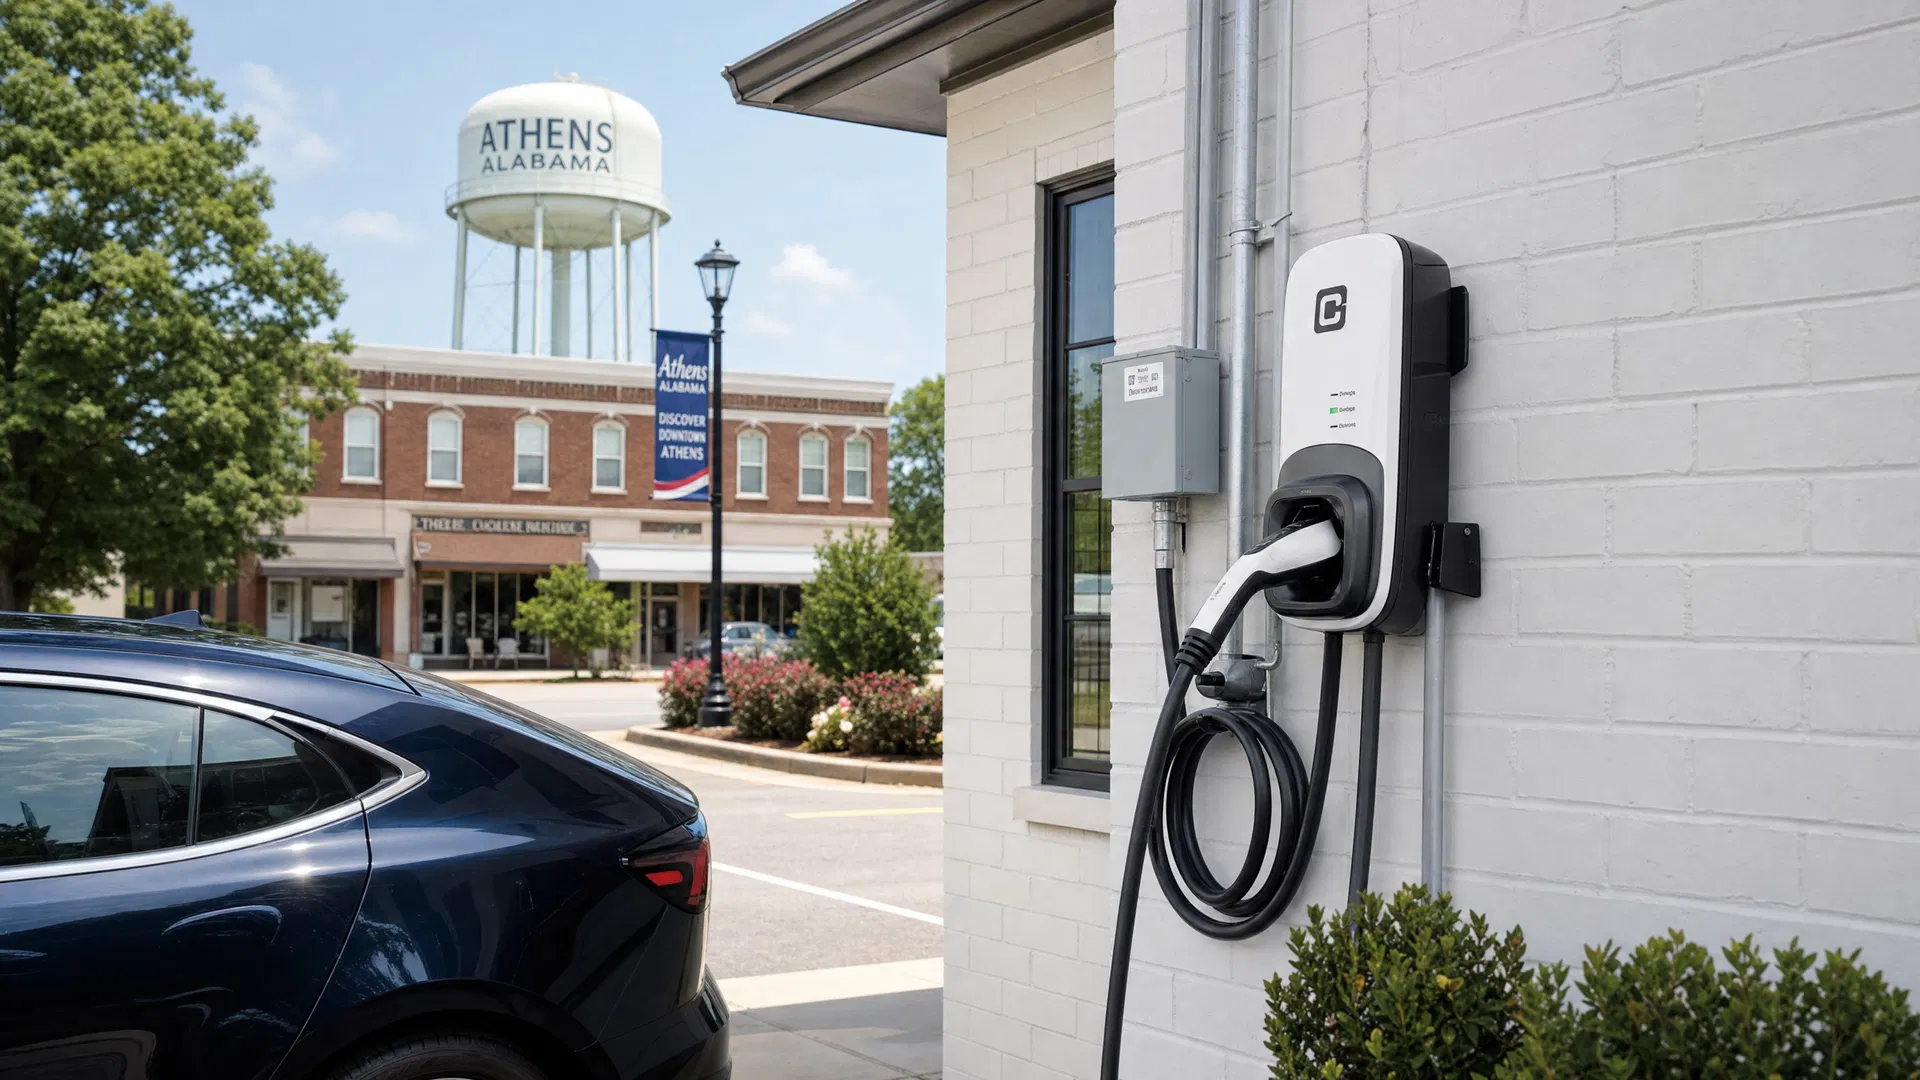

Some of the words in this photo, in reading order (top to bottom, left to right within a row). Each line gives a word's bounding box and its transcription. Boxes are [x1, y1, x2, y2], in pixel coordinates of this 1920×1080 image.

[480, 118, 613, 154] ATHENS
[482, 153, 611, 174] ALABAMA
[657, 353, 708, 381] Athens
[659, 380, 706, 394] ALABAMA
[659, 412, 706, 427] DISCOVER
[659, 428, 706, 443] DOWNTOWN
[660, 444, 704, 460] ATHENS
